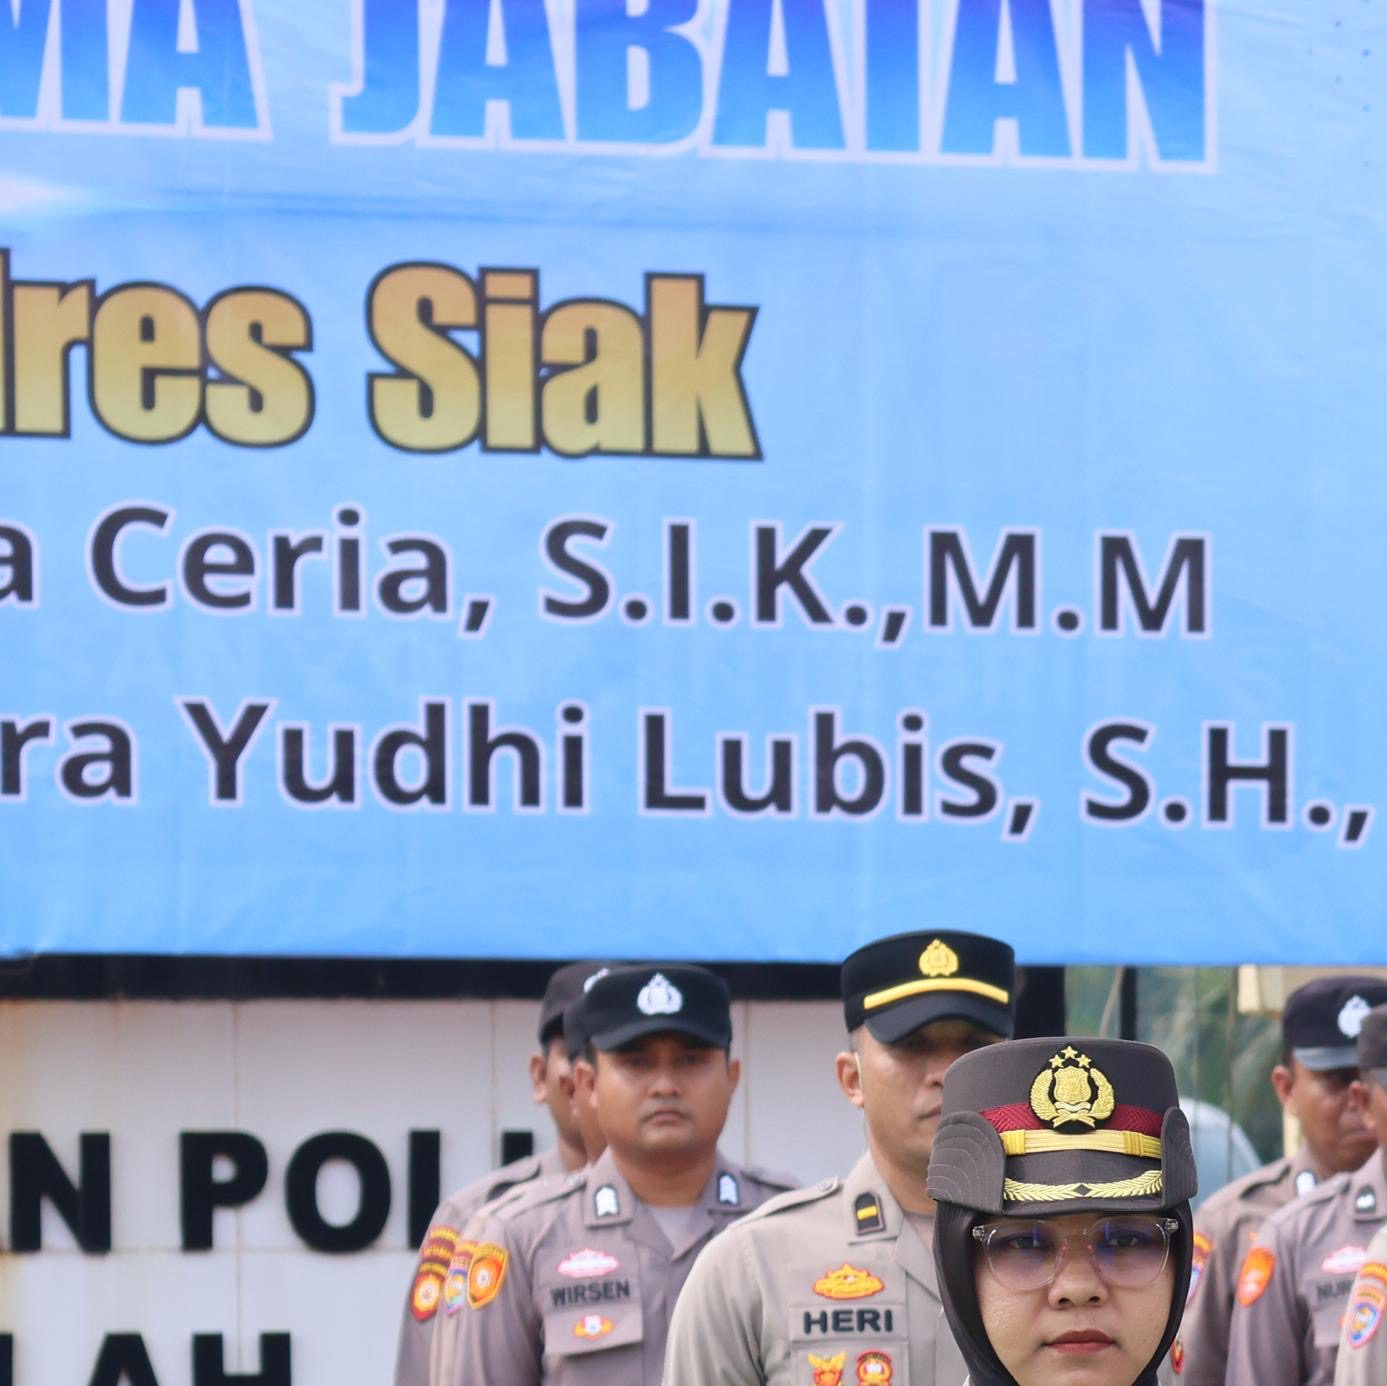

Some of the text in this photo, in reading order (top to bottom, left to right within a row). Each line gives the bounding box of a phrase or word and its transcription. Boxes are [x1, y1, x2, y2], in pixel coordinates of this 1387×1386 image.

[0, 247, 764, 462] res Siak
[92, 506, 491, 633] Ceria,
[182, 702, 586, 808] Yudhi
[645, 711, 1033, 835] Lubis,
[1086, 723, 1369, 842] S.H.,
[549, 1280, 631, 1307] WIRSEN
[803, 1308, 894, 1334] HERI
